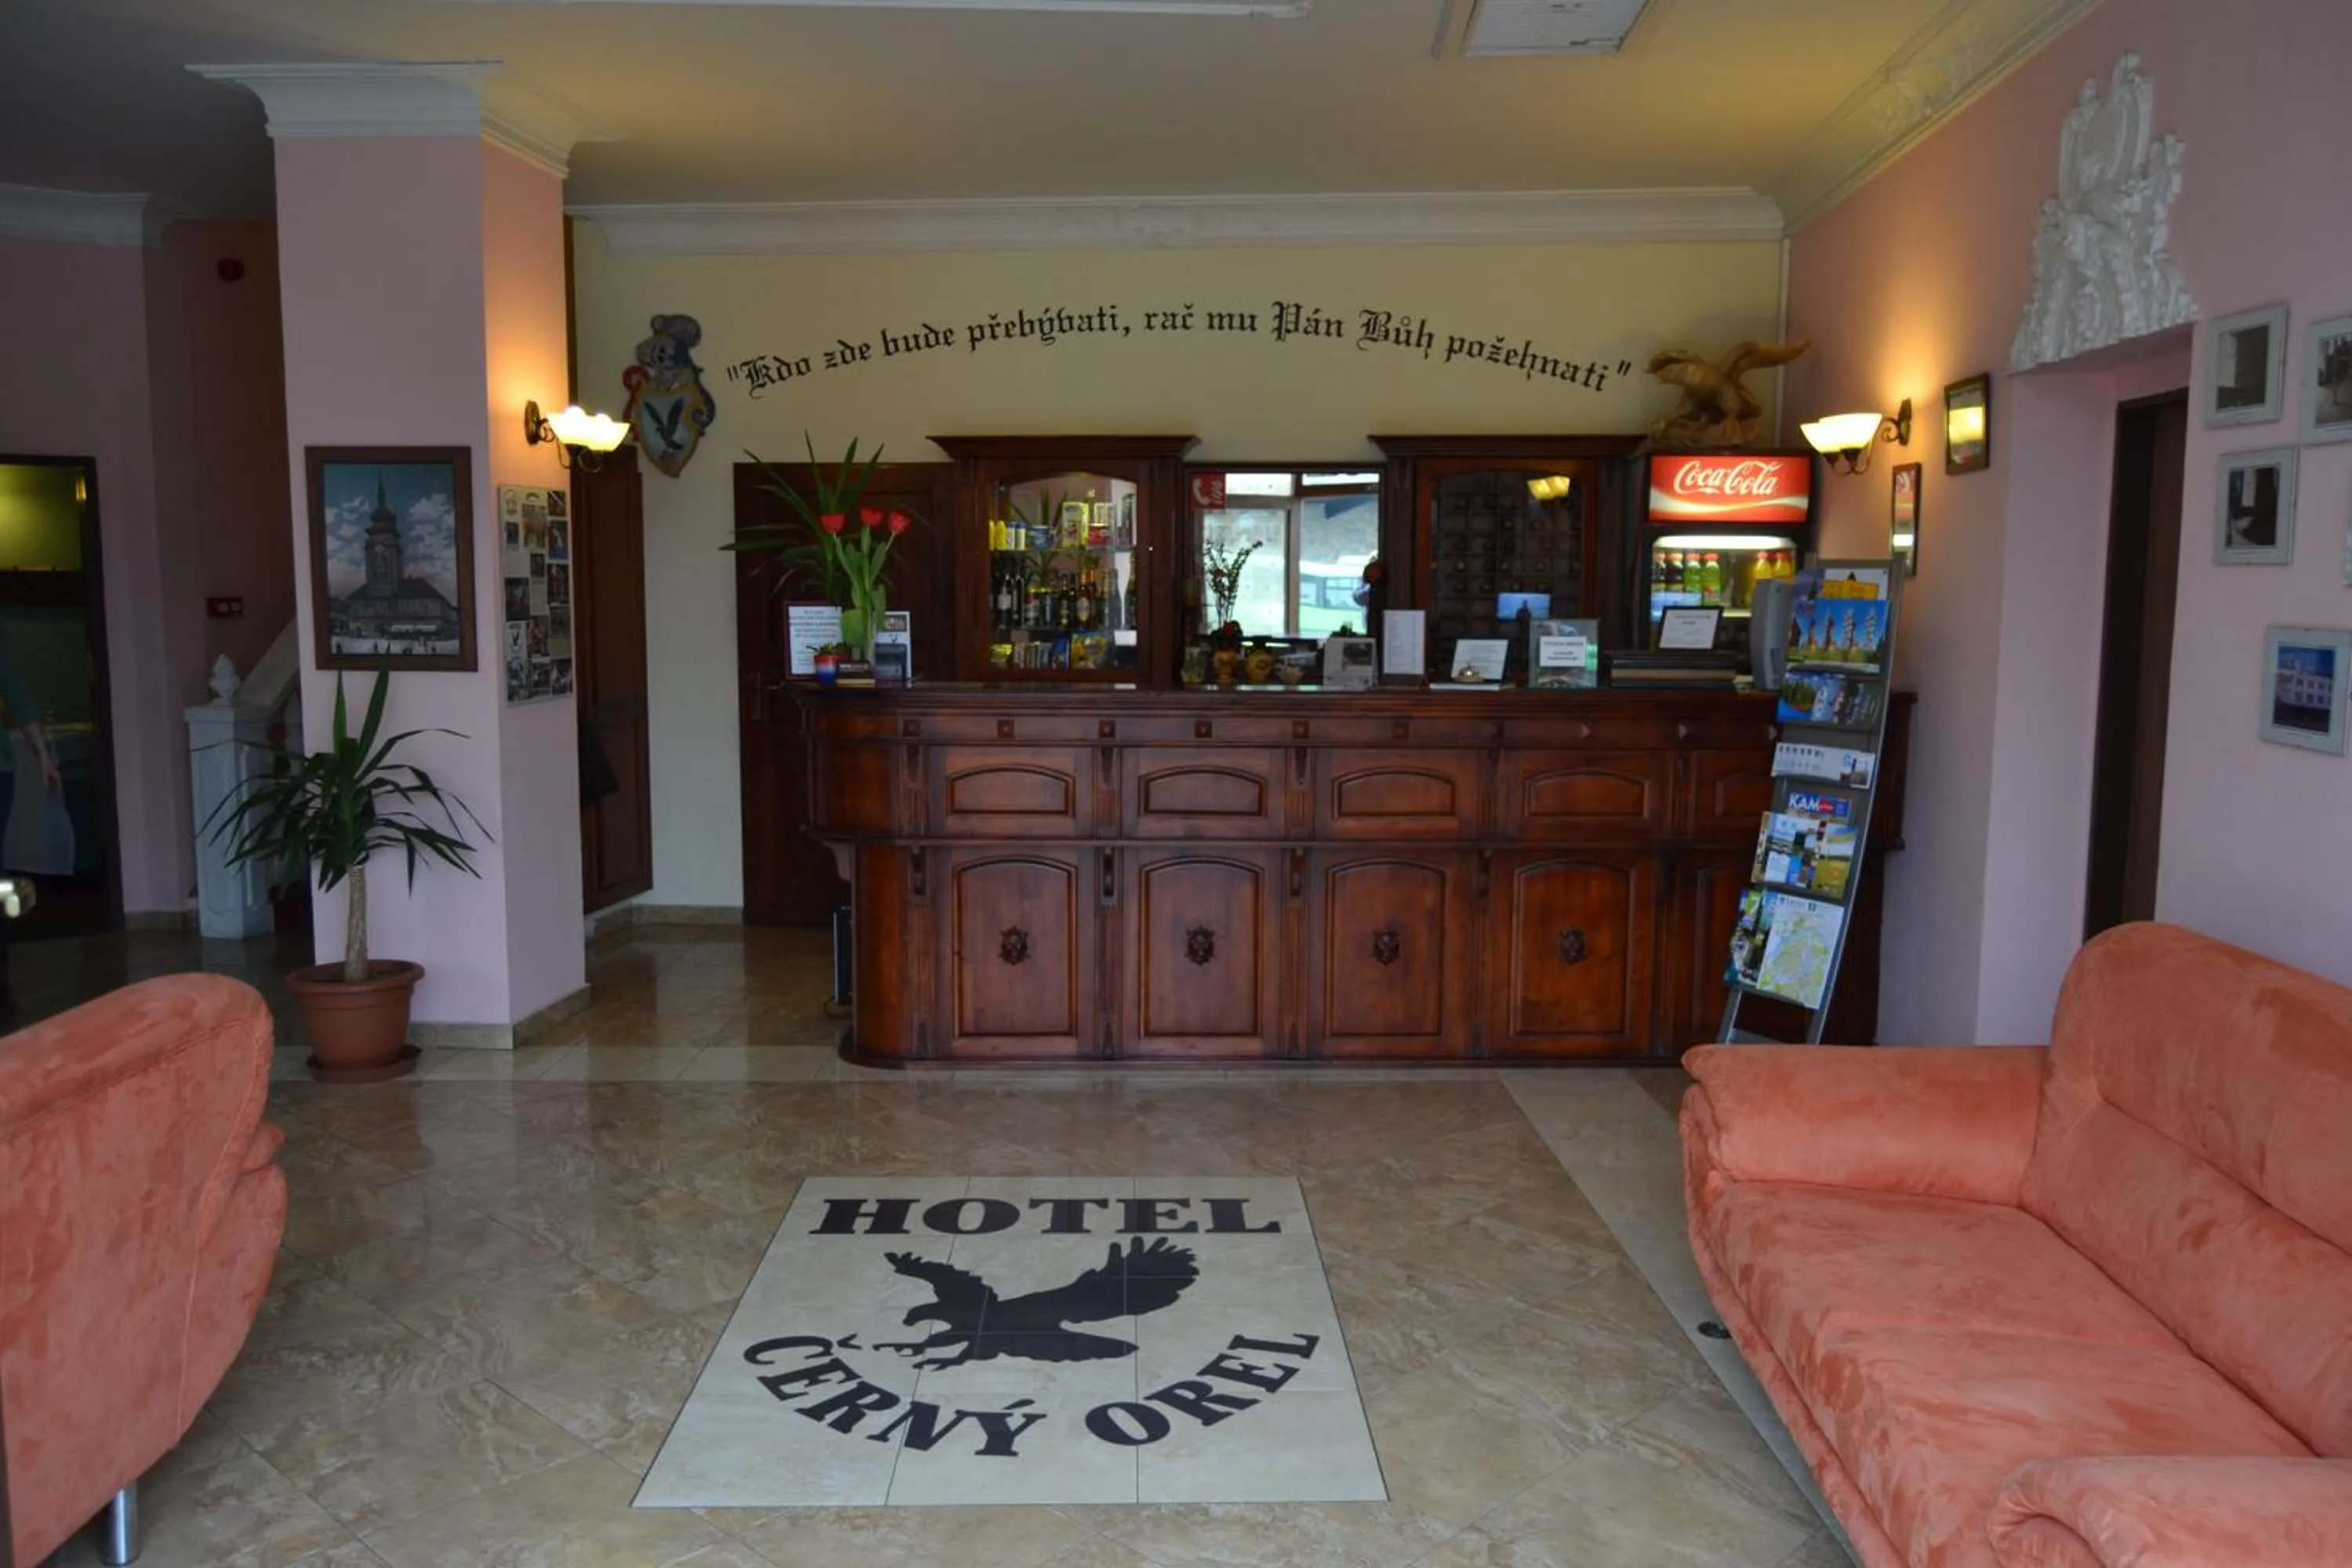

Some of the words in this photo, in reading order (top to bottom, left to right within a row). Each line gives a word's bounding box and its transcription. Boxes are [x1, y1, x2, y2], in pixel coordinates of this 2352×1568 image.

[726, 354, 811, 400] "Kdo
[823, 339, 871, 369] zde
[880, 323, 956, 357] bude
[1143, 303, 1195, 332] rač
[1206, 310, 1258, 332] mu
[1271, 300, 1345, 342] Pán
[1356, 309, 1435, 359] Bůh
[808, 1198, 1281, 1234] HOTEL
[742, 1333, 1048, 1457] ČERNÝ
[1085, 1333, 1320, 1446] OREL
